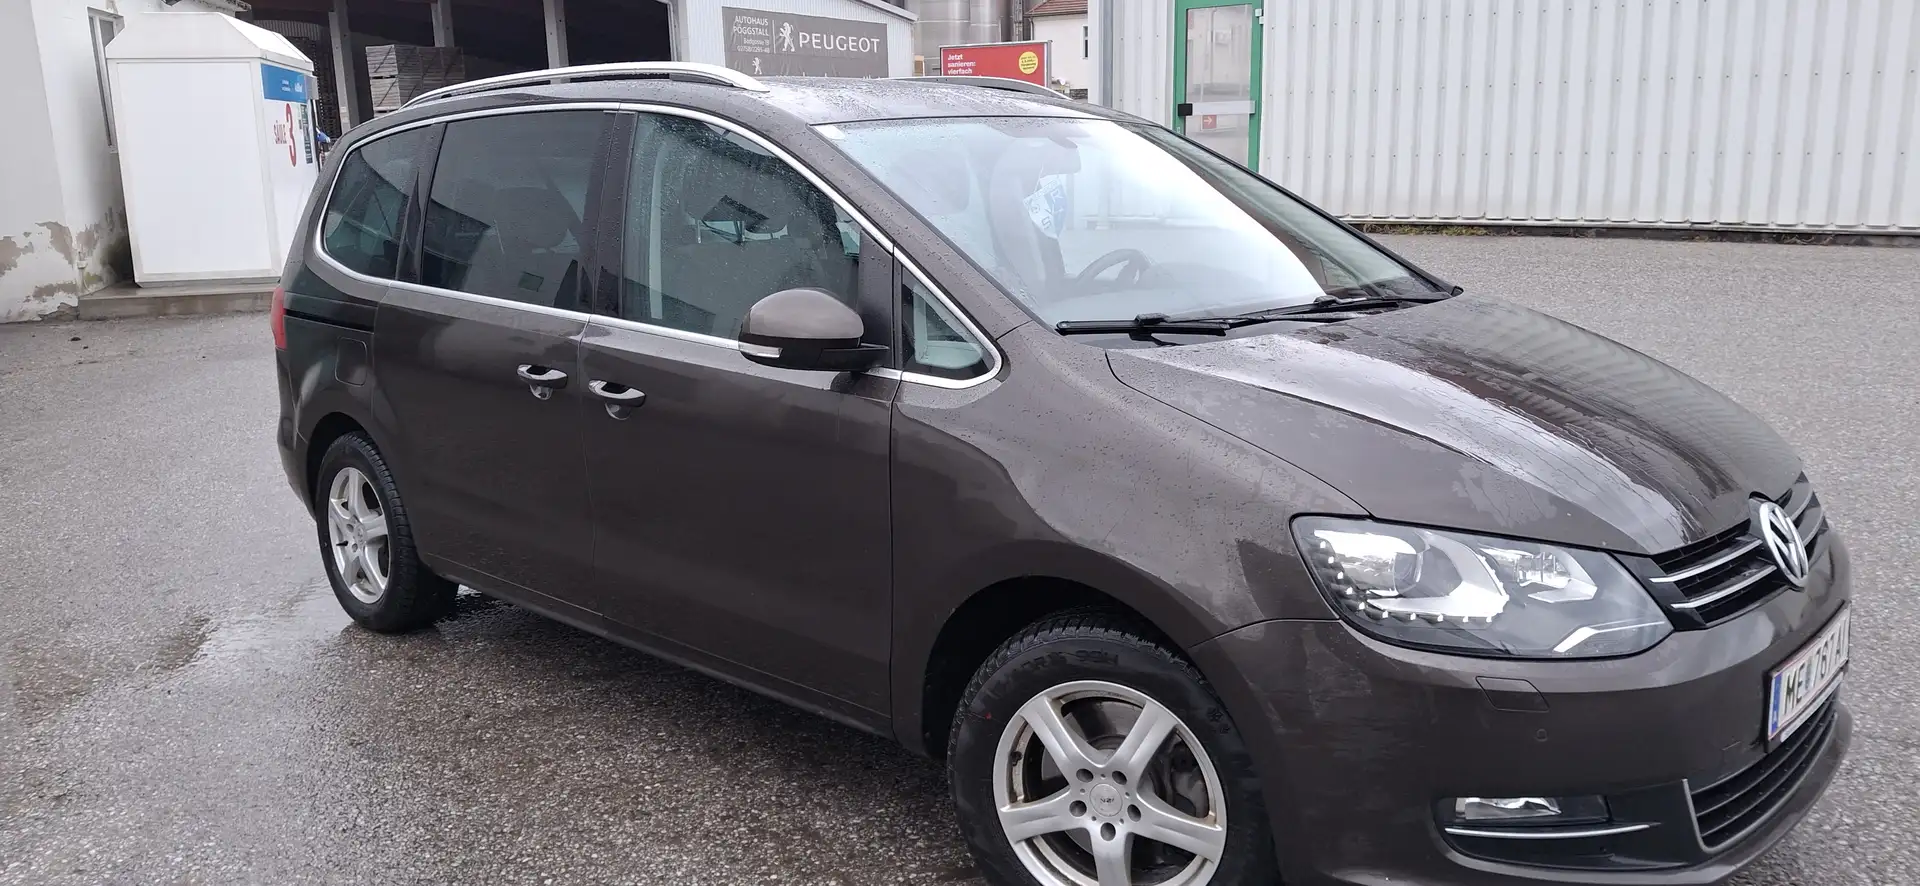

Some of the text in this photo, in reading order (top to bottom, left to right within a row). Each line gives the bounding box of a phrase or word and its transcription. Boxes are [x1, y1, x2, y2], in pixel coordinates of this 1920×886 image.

[735, 16, 769, 26] AUTOHAUS
[799, 31, 880, 53] PEUGEOT
[947, 53, 964, 61] Jetzt
[286, 103, 296, 167] 3
[1783, 661, 1806, 716] ME
[1812, 632, 1836, 689] 767
